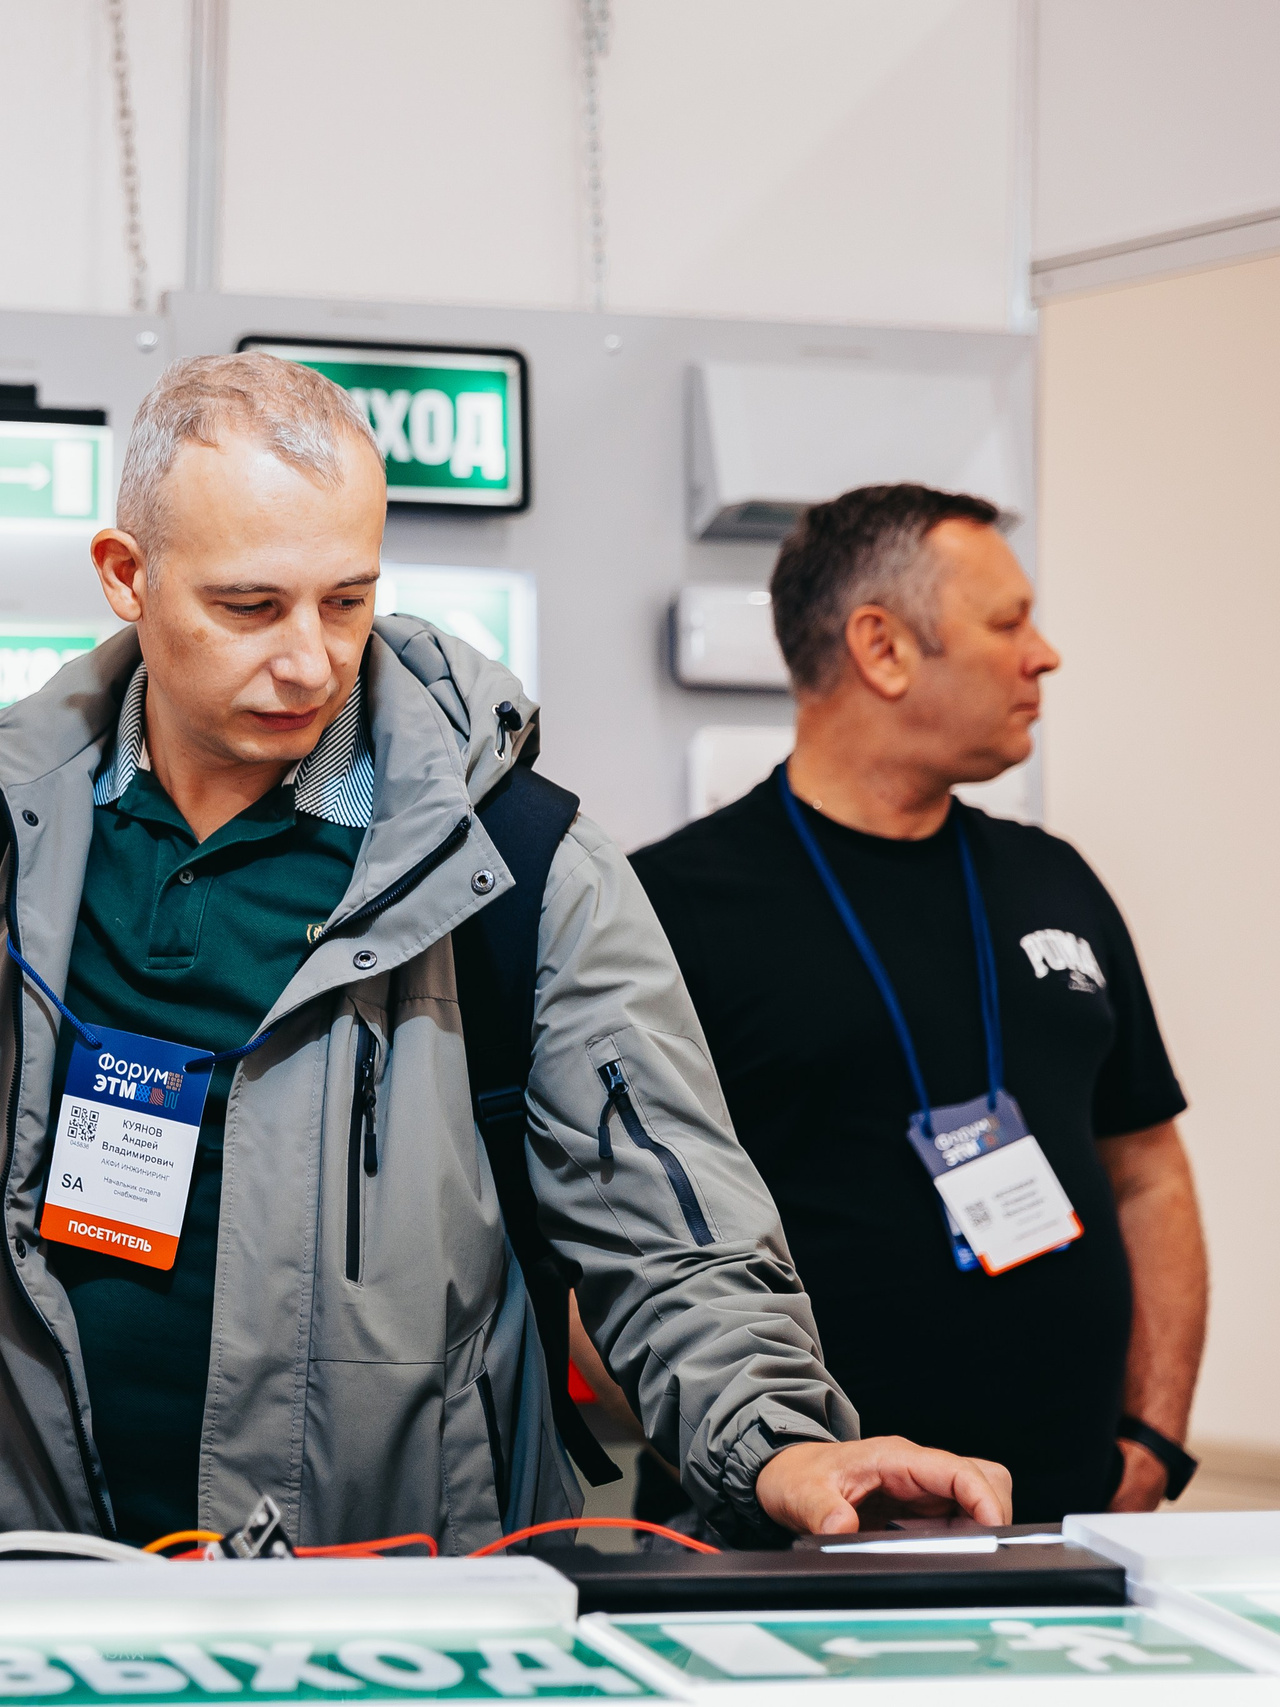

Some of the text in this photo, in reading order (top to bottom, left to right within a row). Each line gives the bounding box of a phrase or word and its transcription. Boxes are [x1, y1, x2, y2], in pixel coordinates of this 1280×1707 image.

[348, 387, 506, 481] ХОД
[98, 1052, 169, 1084] Форум
[93, 1074, 135, 1100] ЭТМ
[122, 1119, 163, 1138] КУЯНОВ
[122, 1133, 159, 1150] Андрей
[102, 1141, 175, 1168] Владимирович
[61, 1173, 84, 1193] SA
[138, 1186, 162, 1198] отдела
[113, 1189, 149, 1203] снабжения
[67, 1219, 152, 1253] ПОСЕТИТЕЛЬ
